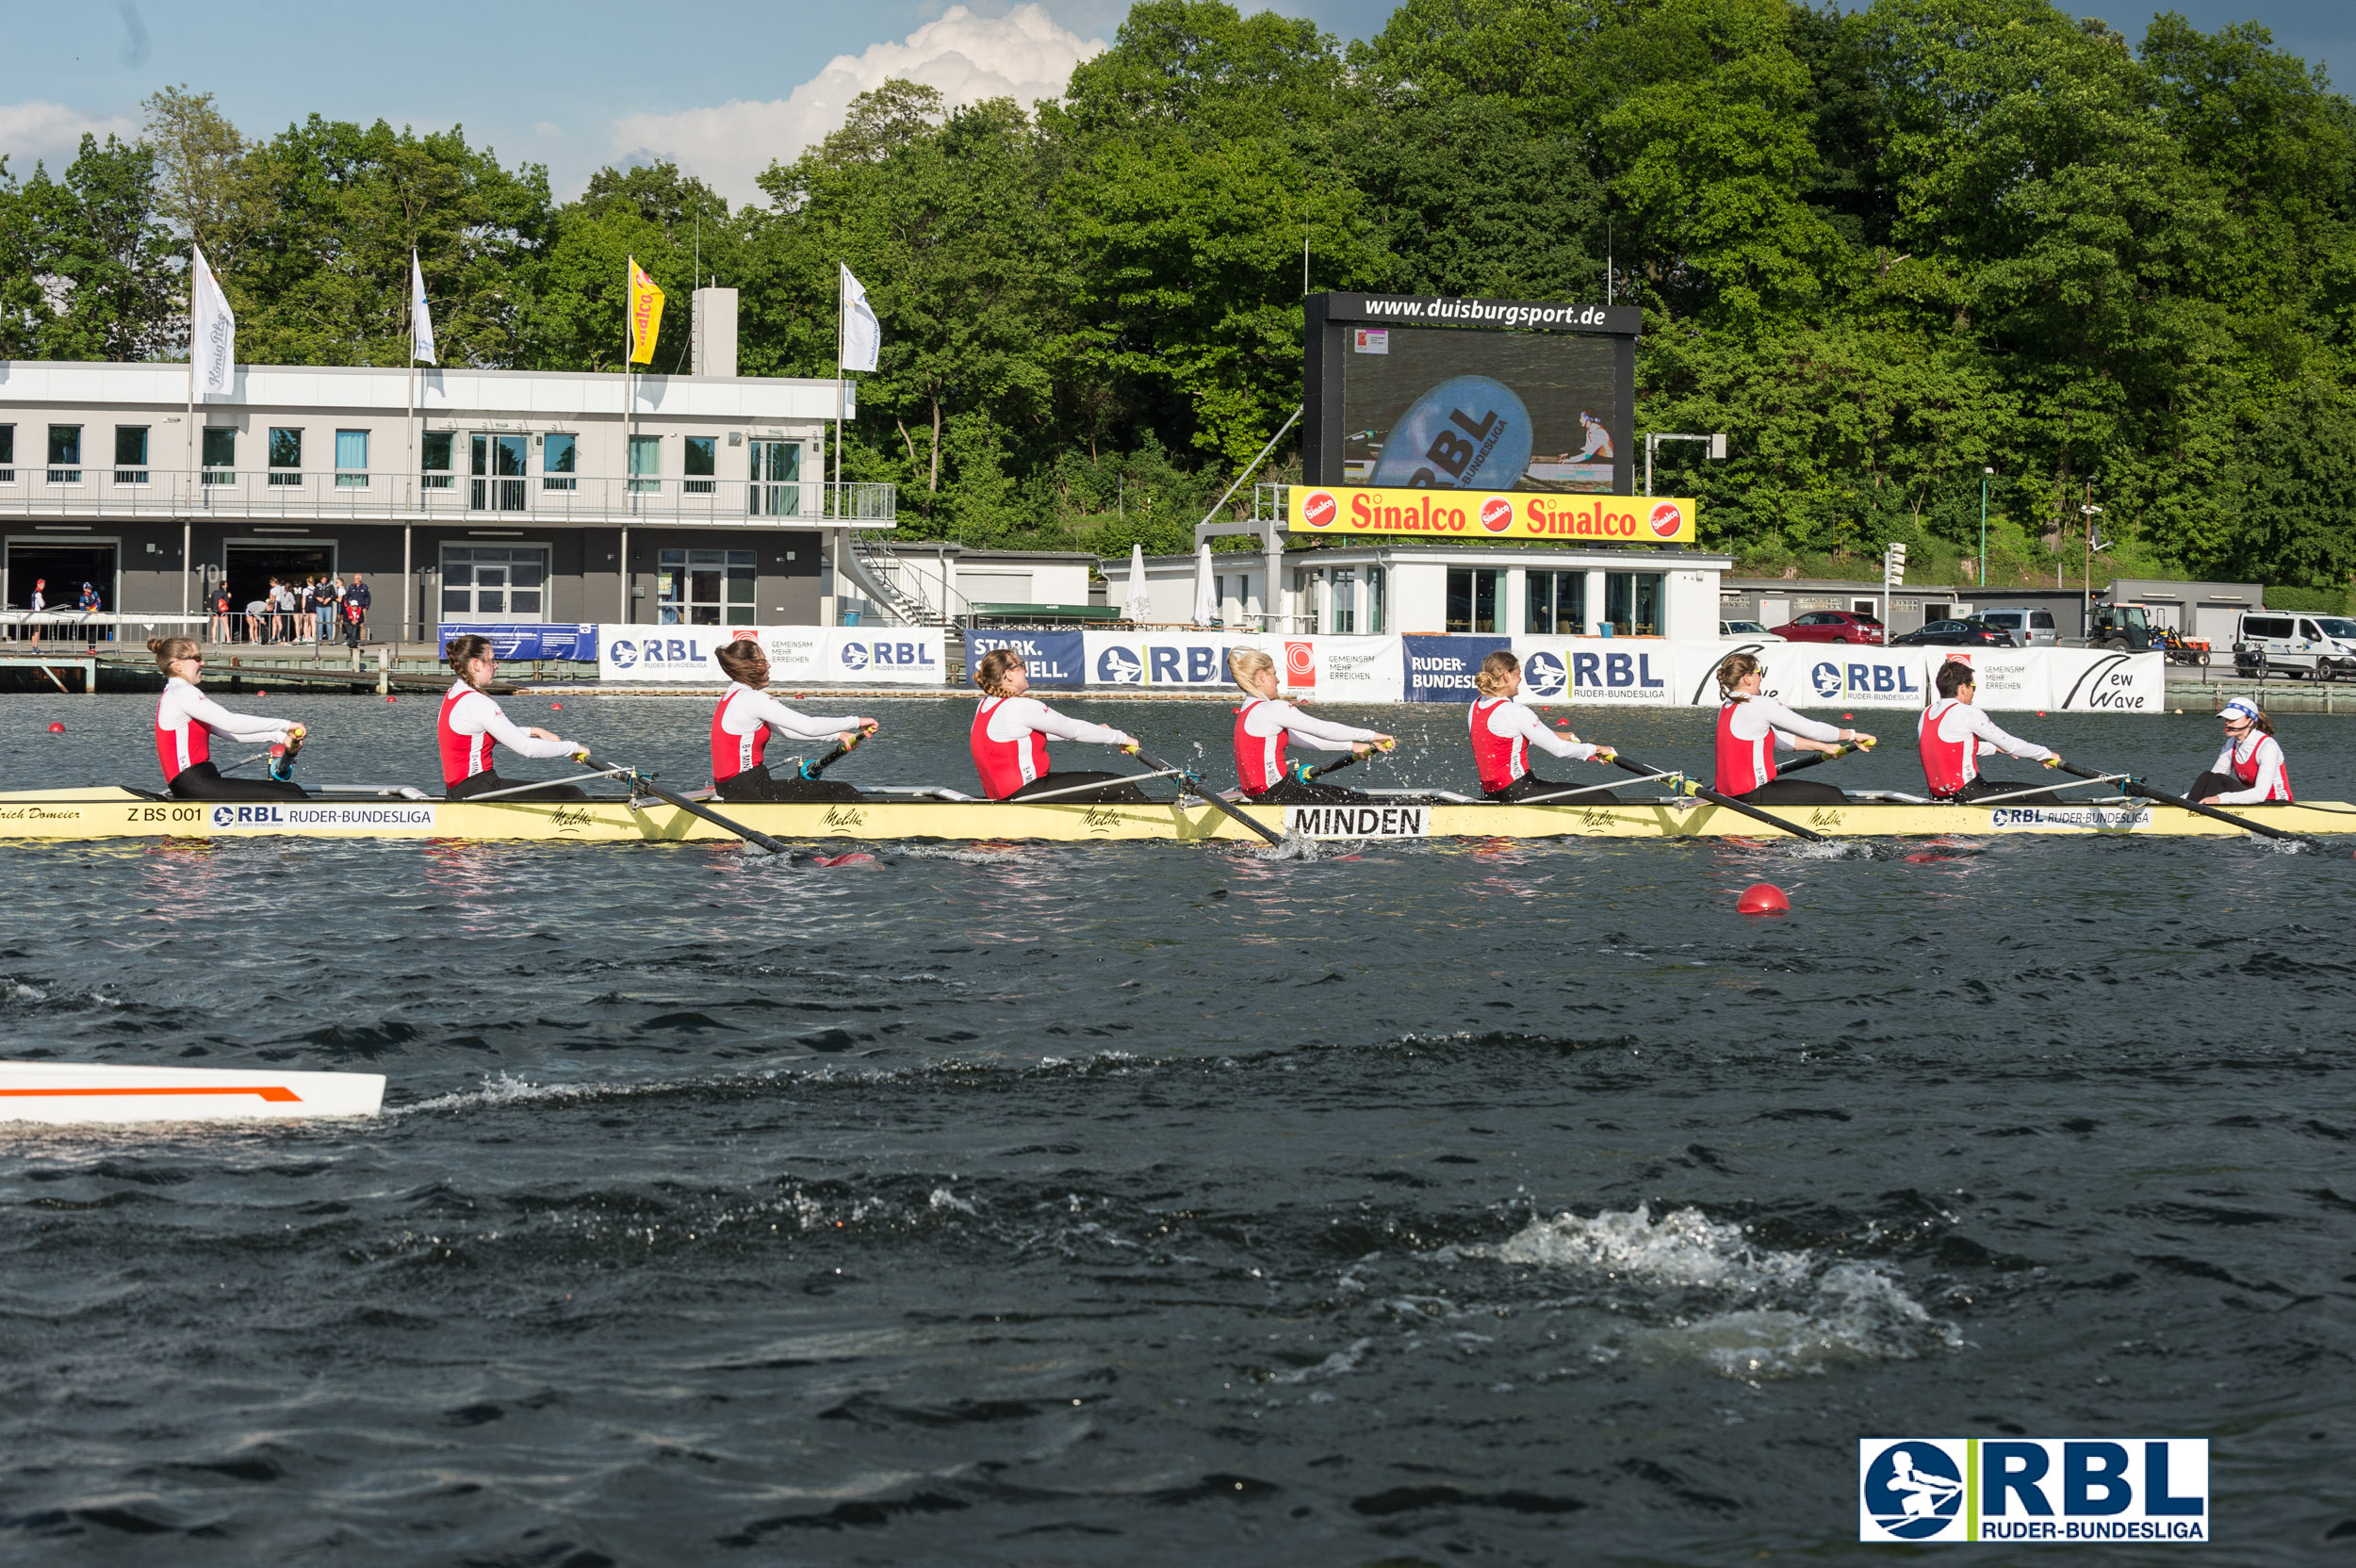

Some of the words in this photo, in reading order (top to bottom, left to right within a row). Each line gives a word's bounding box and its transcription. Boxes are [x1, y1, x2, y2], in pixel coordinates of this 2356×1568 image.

[1366, 299, 1606, 325] www.duisburgsport.de
[1458, 419, 1508, 488] -BUNDESLIGA
[1305, 498, 1334, 519] Sinalco
[1350, 493, 1466, 531] Sinalco
[1482, 504, 1510, 526] Sinalco
[1527, 498, 1637, 536] Sinalco
[1651, 509, 1678, 530] Sinalco
[195, 564, 220, 583] 10
[644, 640, 707, 662] RBL
[874, 643, 935, 664] RBL
[973, 638, 1043, 656] STARK.
[1328, 655, 1375, 663] GEMEINSAM
[1413, 657, 1467, 672] RUDER-
[1572, 652, 1664, 688] RBL
[1848, 663, 1919, 693] RBL
[1984, 665, 2025, 674] GEMEINSAM
[1574, 689, 1665, 698] RUDER-BUNDESLIGA
[1847, 693, 1920, 701] RUDER-BUNDESLIGA
[742, 743, 751, 753] 8+
[742, 755, 751, 769] MIN
[0, 808, 25, 819] rich
[28, 808, 81, 819] Domeier
[127, 808, 139, 821] Z
[144, 808, 167, 821] BS
[172, 808, 202, 821] 001
[237, 807, 283, 822] RBL
[289, 810, 431, 823] RUDER-BUNDESLIGA
[548, 804, 592, 826] Melitta
[818, 805, 864, 826] Melitta
[1077, 806, 1122, 826] Melitta
[1295, 808, 1421, 835] MINDEN
[1576, 806, 1616, 826] Melitta
[1805, 806, 1843, 826] Melitta
[2010, 809, 2044, 823] RBL
[2048, 812, 2149, 824] RUDER-BUNDESLIGA
